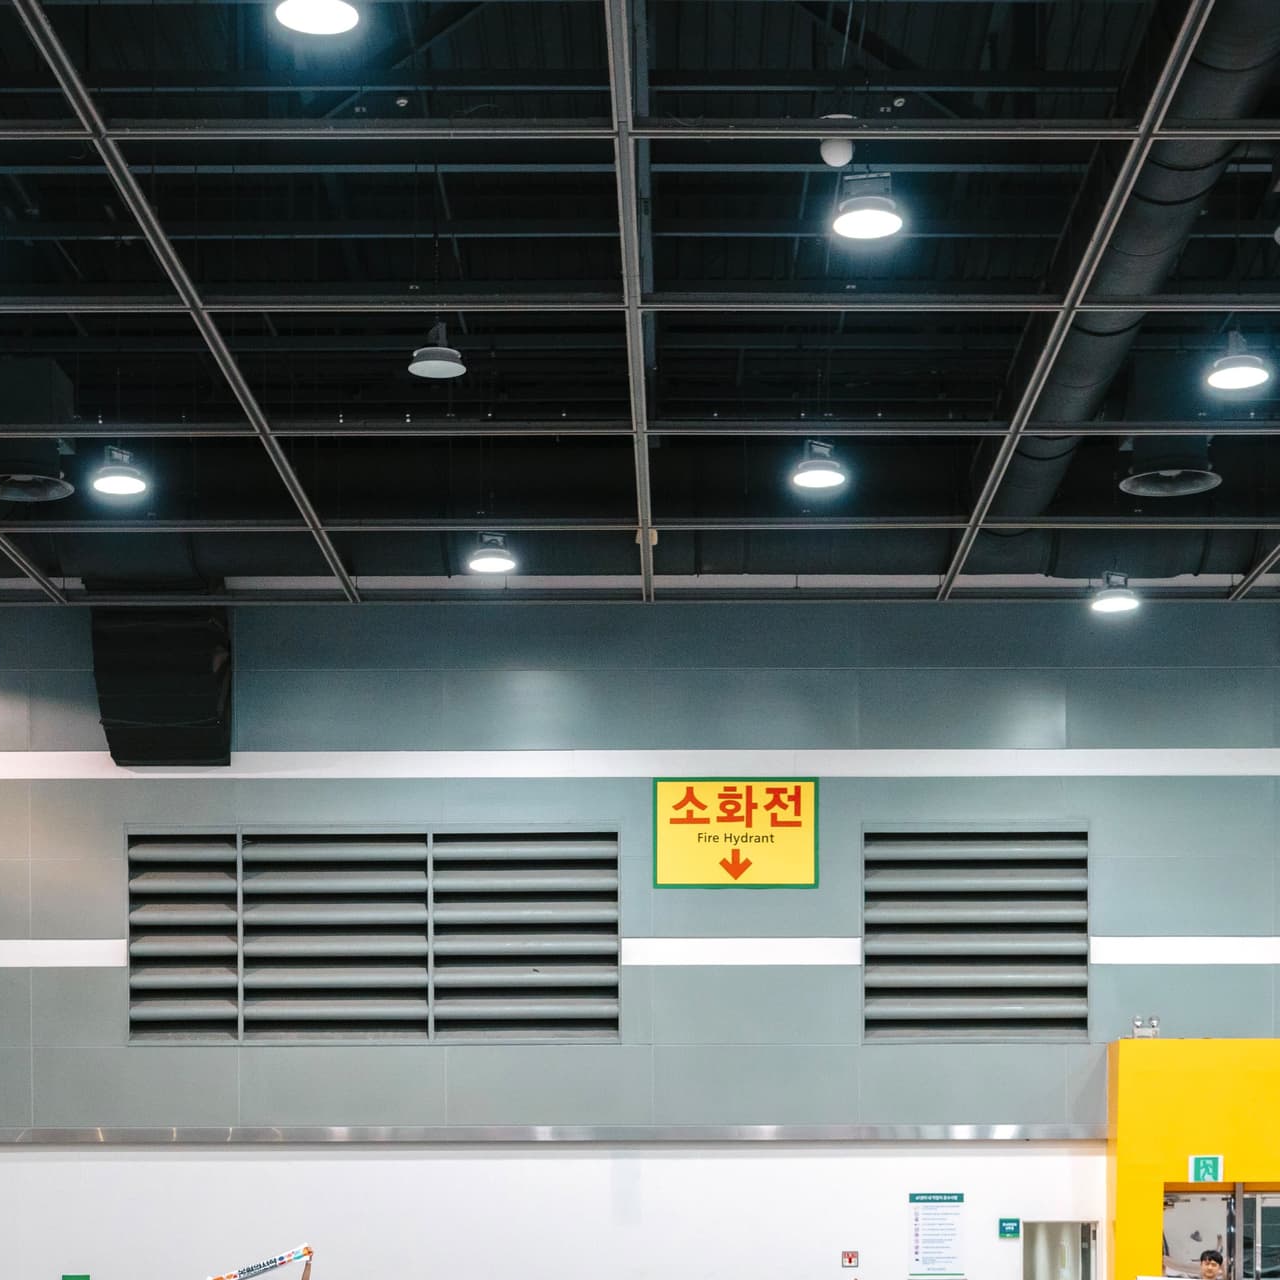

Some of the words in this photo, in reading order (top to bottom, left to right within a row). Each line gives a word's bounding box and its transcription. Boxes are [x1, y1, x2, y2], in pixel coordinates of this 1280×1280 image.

[669, 785, 802, 828] 소화전
[697, 832, 720, 843] Fire
[724, 832, 775, 846] Hydrant
